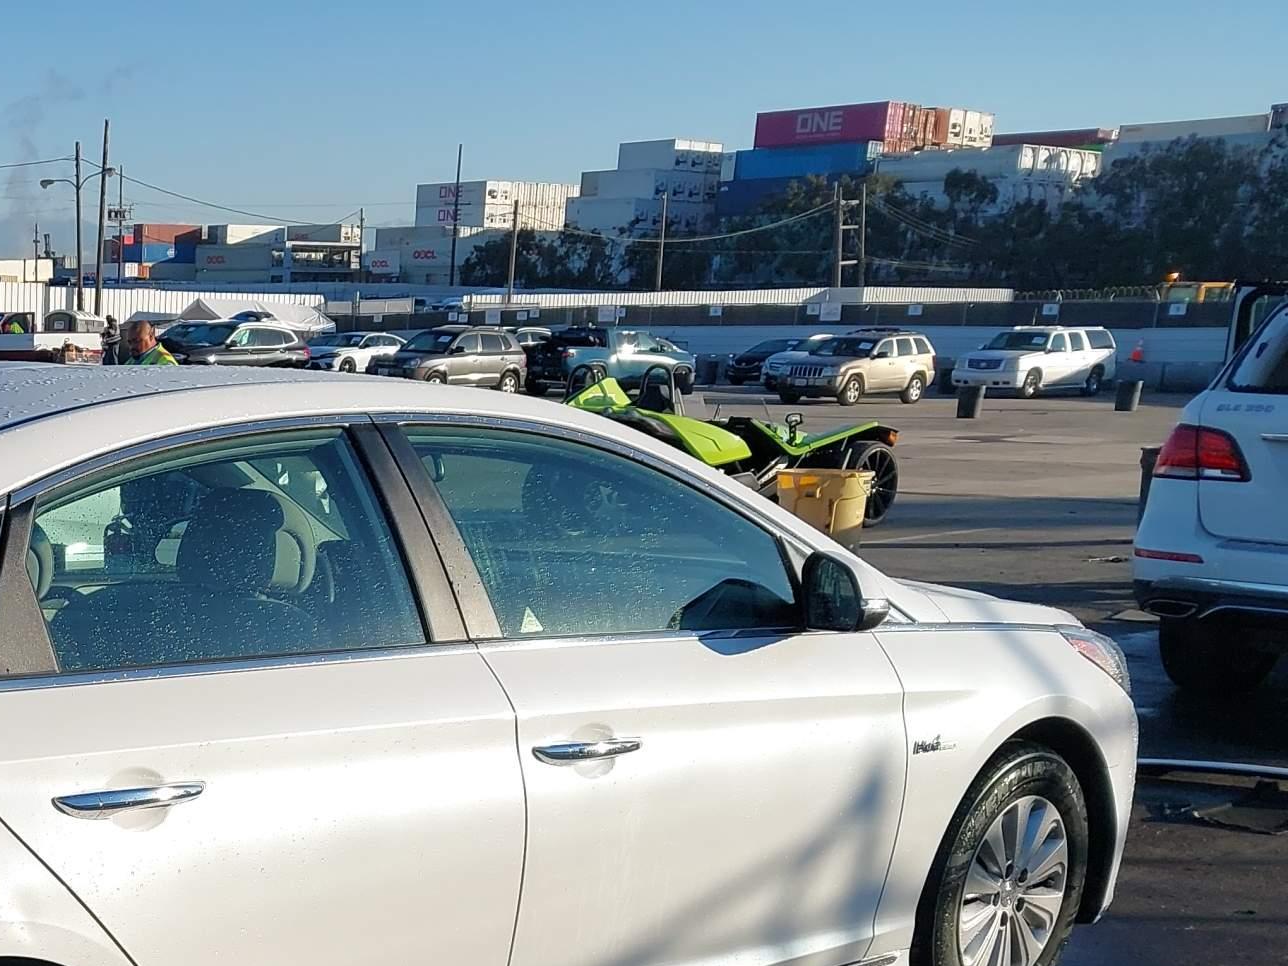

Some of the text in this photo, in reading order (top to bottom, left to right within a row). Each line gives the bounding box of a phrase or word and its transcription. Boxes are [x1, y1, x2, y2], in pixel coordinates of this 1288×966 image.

[796, 111, 843, 133] ONE
[439, 185, 463, 199] ONE
[437, 209, 462, 222] ONE
